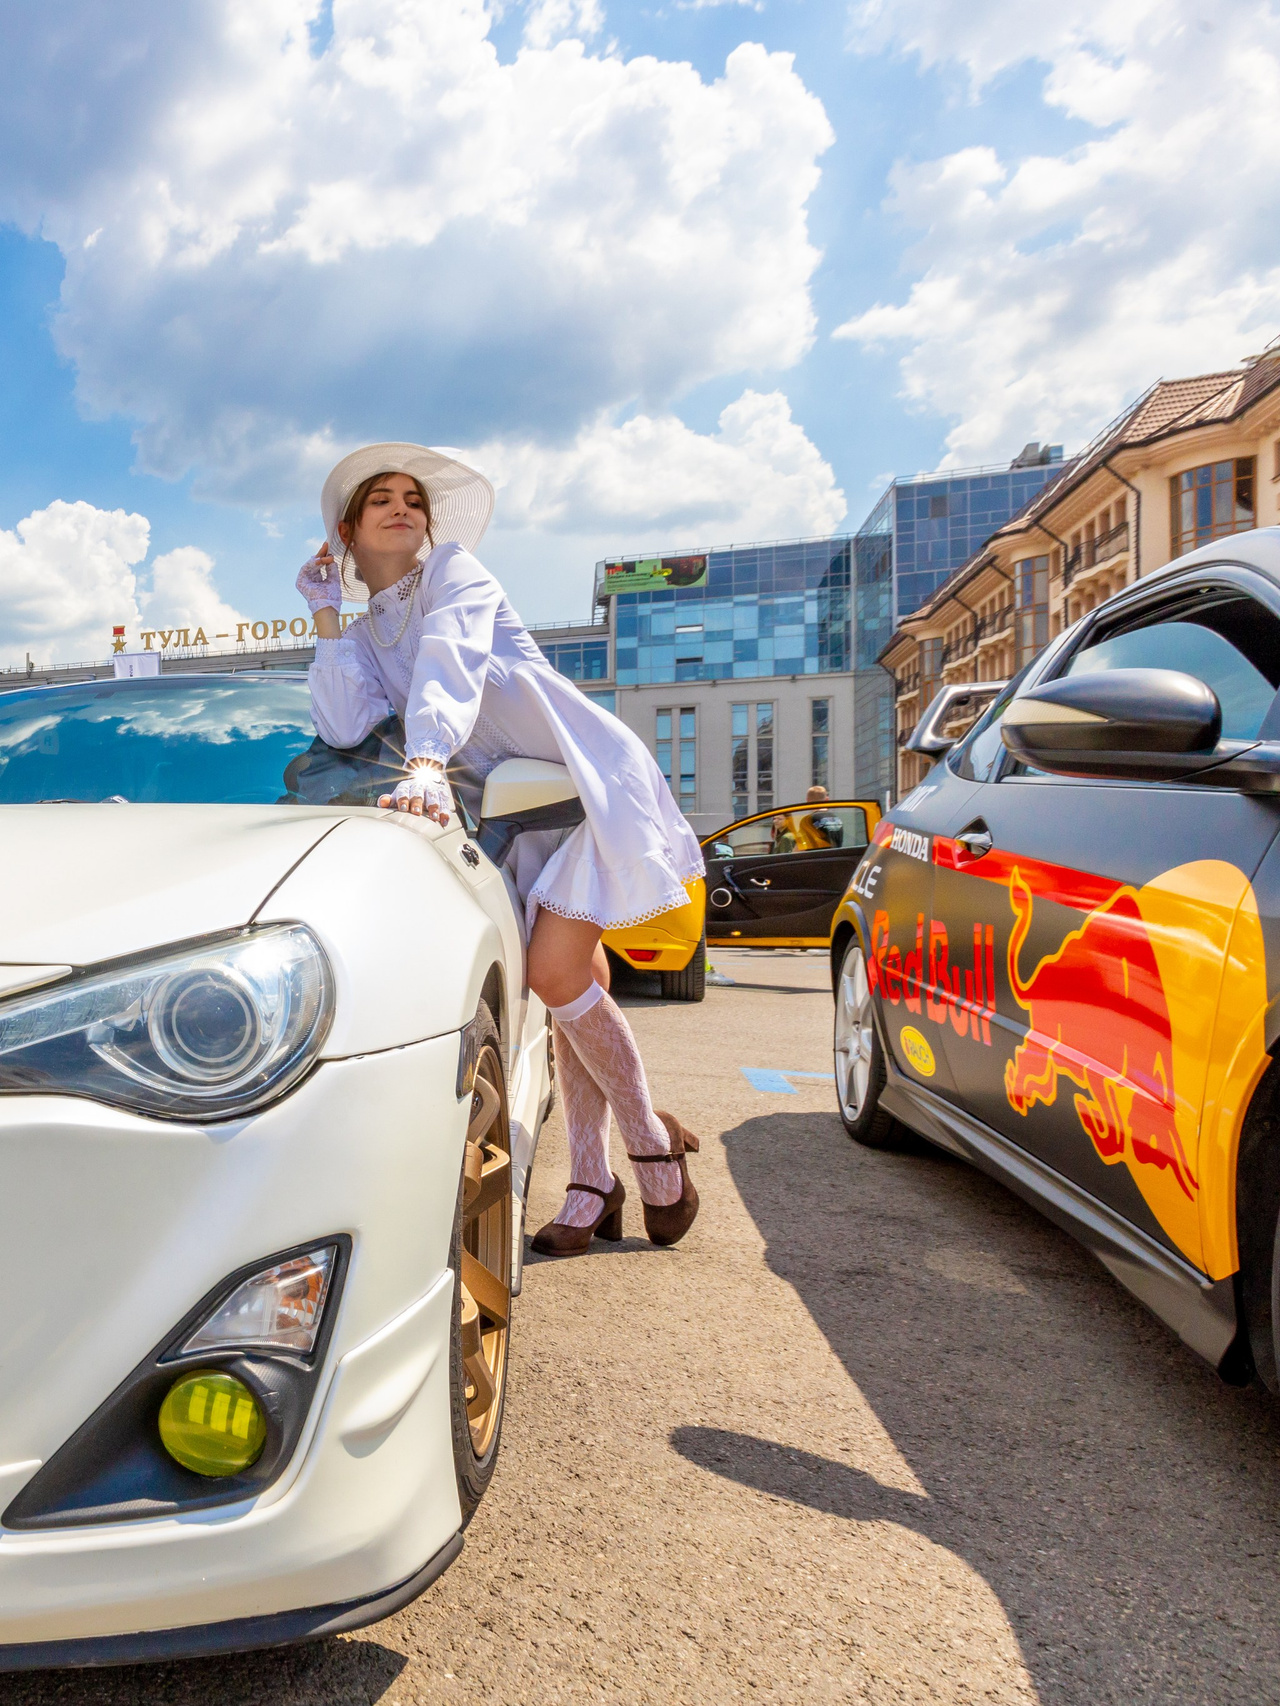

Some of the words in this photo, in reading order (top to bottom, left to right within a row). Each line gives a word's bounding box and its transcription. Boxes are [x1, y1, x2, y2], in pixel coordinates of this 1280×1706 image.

[140, 626, 210, 651] ТУЛА
[890, 827, 930, 862] HONDA
[867, 909, 925, 1016] Red
[926, 919, 996, 1047] Bull
